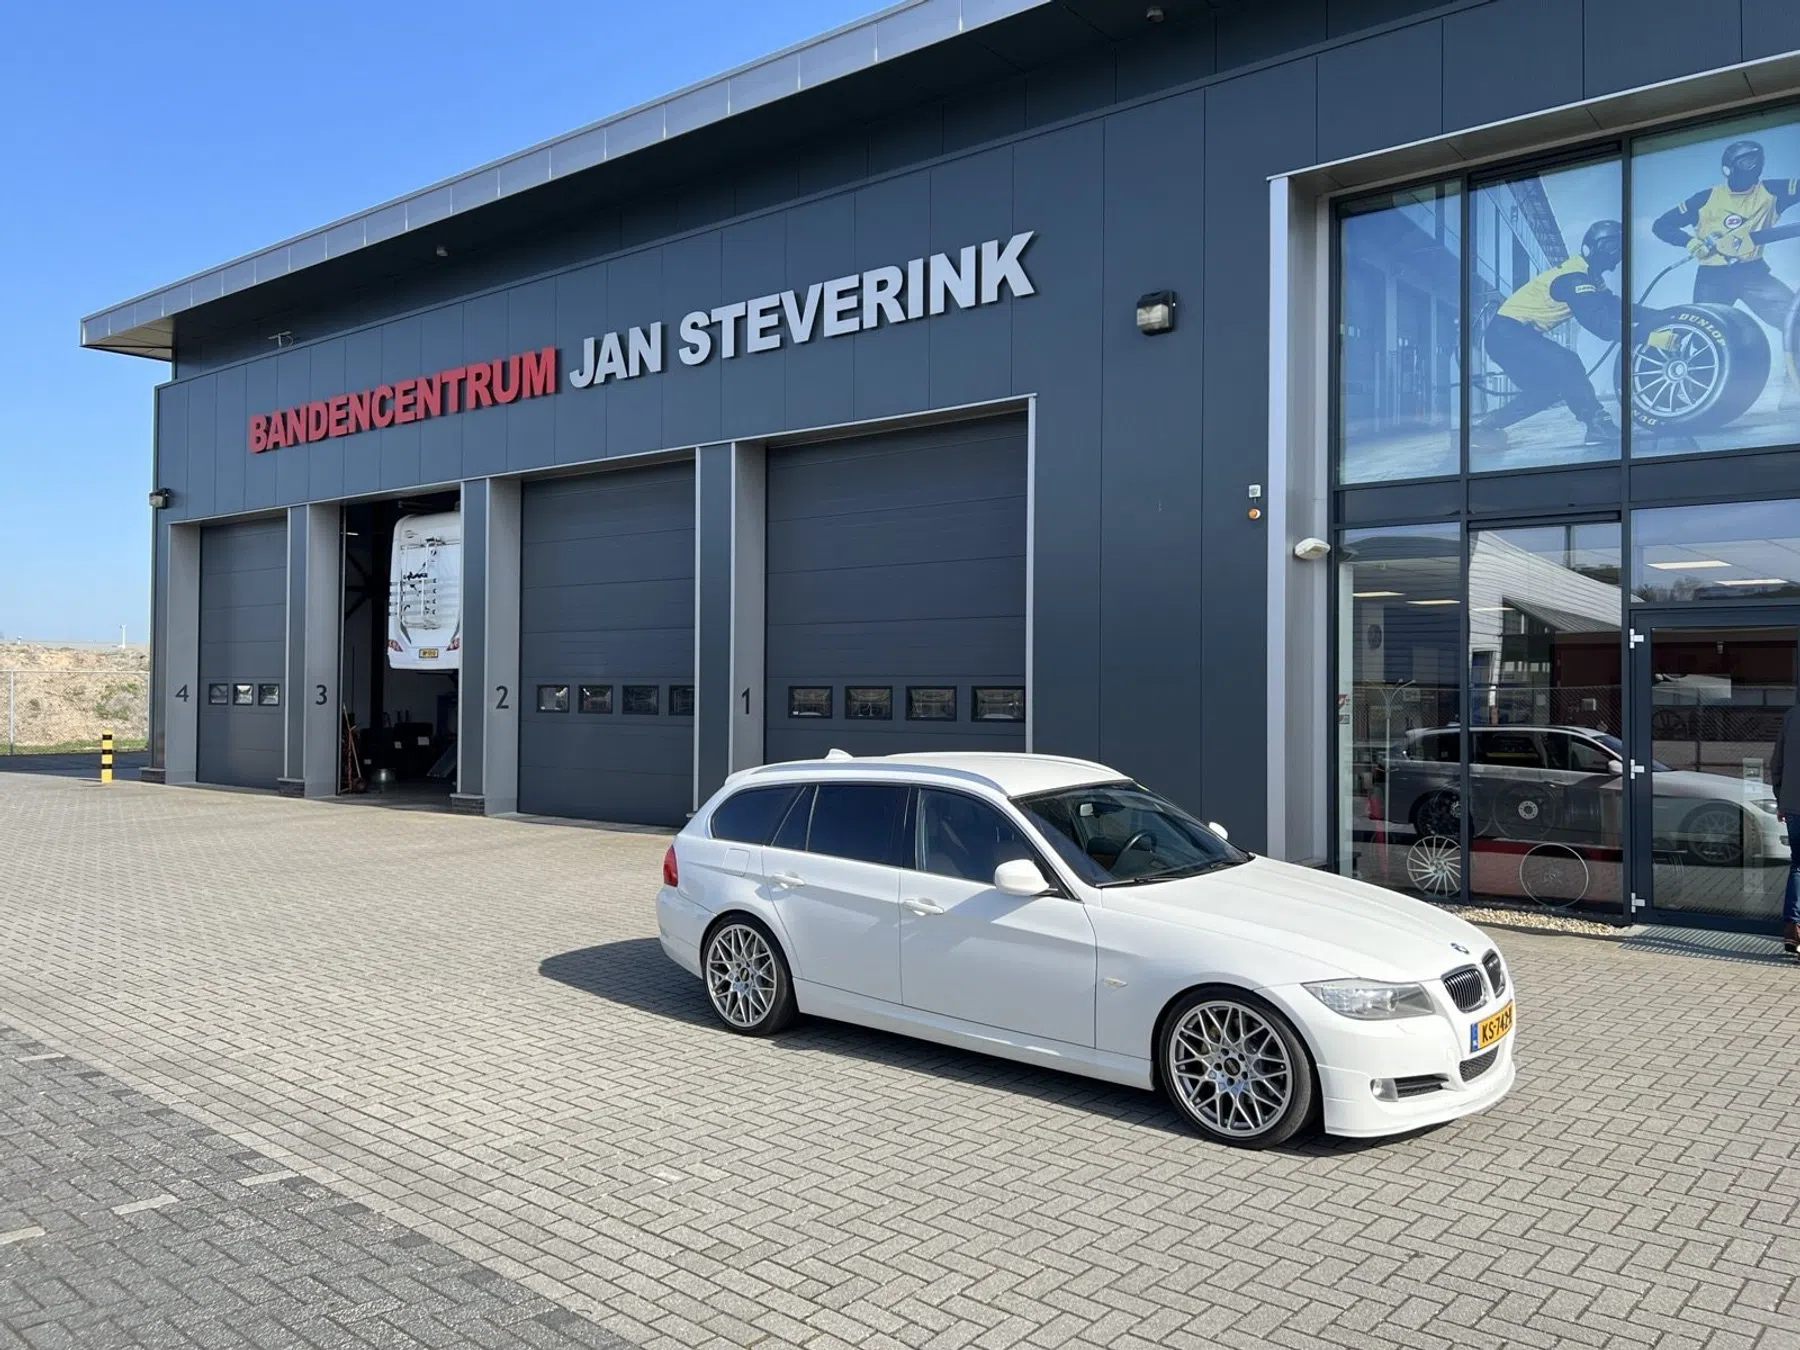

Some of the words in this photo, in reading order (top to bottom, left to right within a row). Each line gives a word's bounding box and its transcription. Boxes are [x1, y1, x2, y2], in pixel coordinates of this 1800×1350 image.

[249, 345, 557, 454] BANDENCENTRUM
[569, 321, 662, 388] JAN
[678, 230, 1036, 366] STEVERINK
[1678, 312, 1727, 347] DUNLOP
[175, 684, 189, 702] 4
[315, 684, 328, 705] 3
[495, 685, 509, 709] 2
[741, 687, 751, 715] 1
